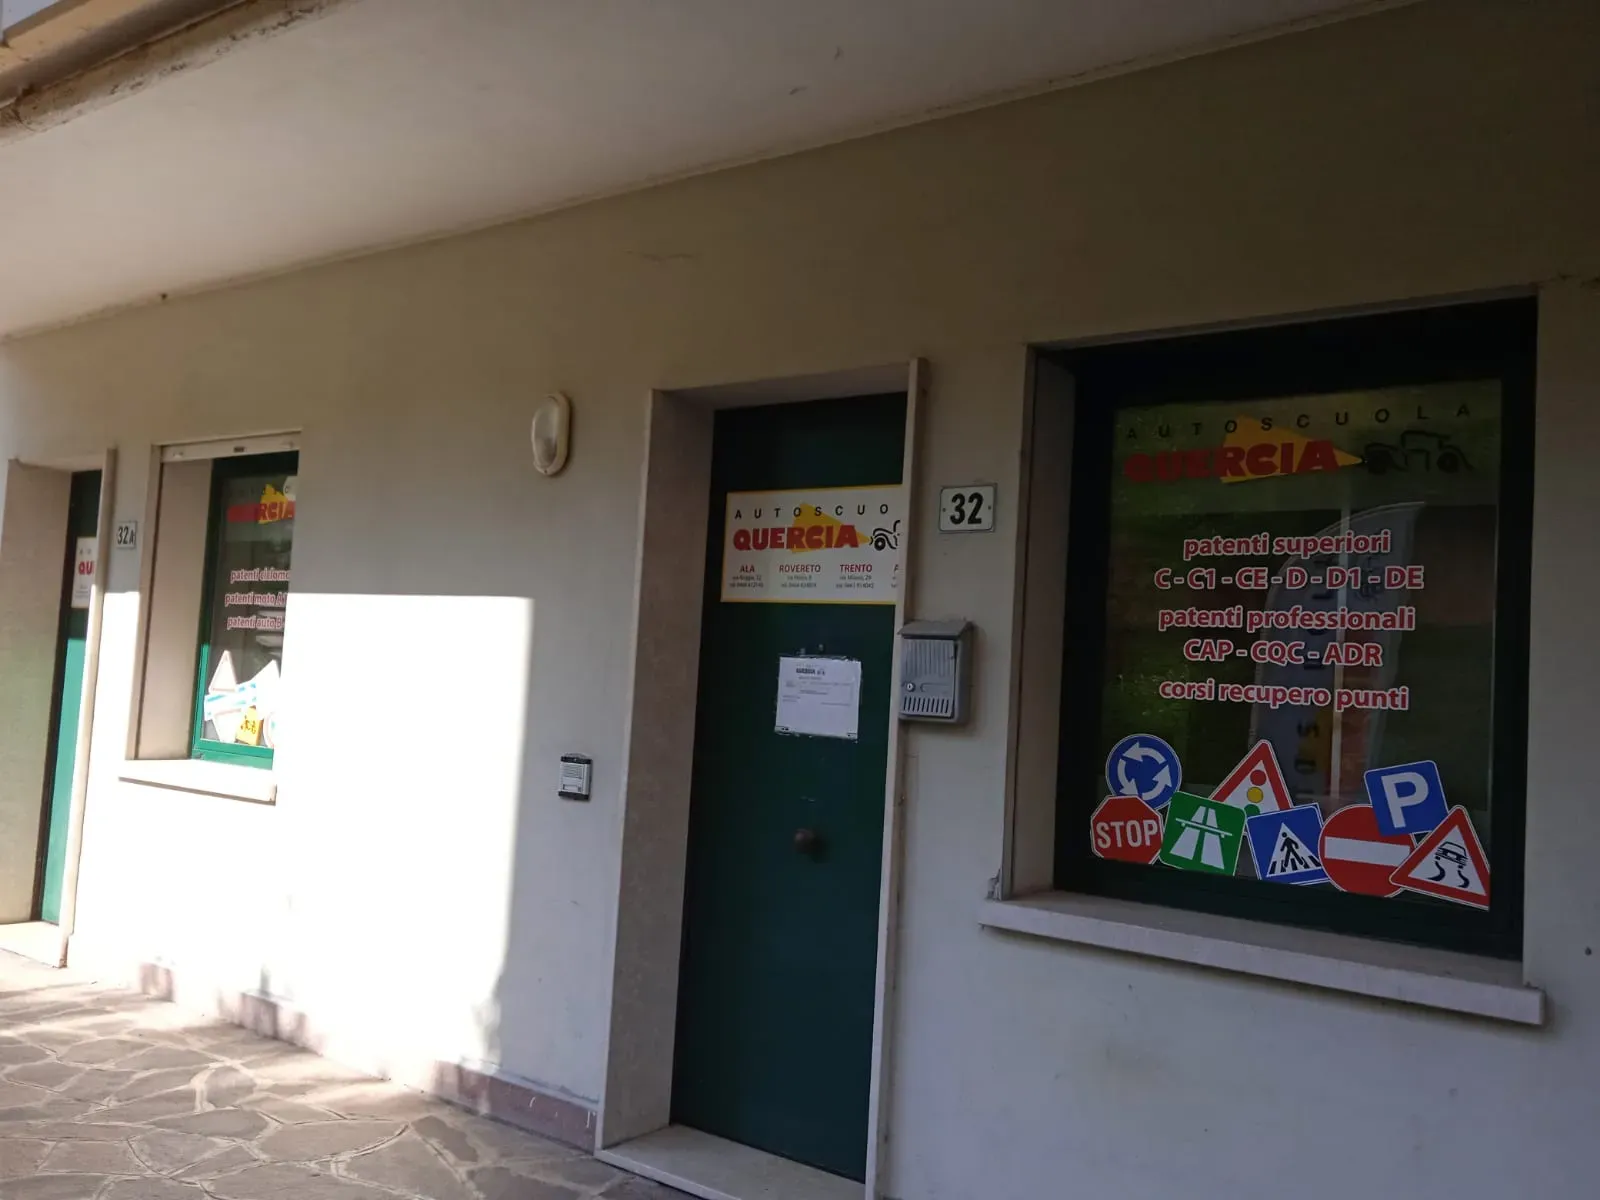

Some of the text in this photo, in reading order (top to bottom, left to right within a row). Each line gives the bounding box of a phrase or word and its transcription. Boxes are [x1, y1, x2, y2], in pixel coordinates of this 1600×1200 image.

[1126, 404, 1470, 440] AUTOSCUOLA
[1123, 440, 1339, 483] QUERCIA
[950, 492, 984, 525] 32
[117, 526, 134, 544] 32A
[733, 525, 859, 551] QUERCIA
[1183, 530, 1391, 560] patenti superiori
[739, 563, 873, 573] ALA ROVERETO TRENTO
[1154, 568, 1171, 589] C
[1187, 568, 1216, 590] C1
[1235, 567, 1268, 589] CE
[1286, 567, 1307, 589] D
[1327, 567, 1361, 589] D1
[1385, 566, 1424, 589] DE
[225, 592, 254, 607] patenti
[227, 615, 256, 630] patenti
[1159, 605, 1415, 632] patenti professionali
[1184, 639, 1233, 662] CAP
[1251, 641, 1304, 666] CQC
[1322, 642, 1382, 666] ADR
[1160, 678, 1408, 711] corsi recupero punti
[1095, 818, 1160, 850] STOP
